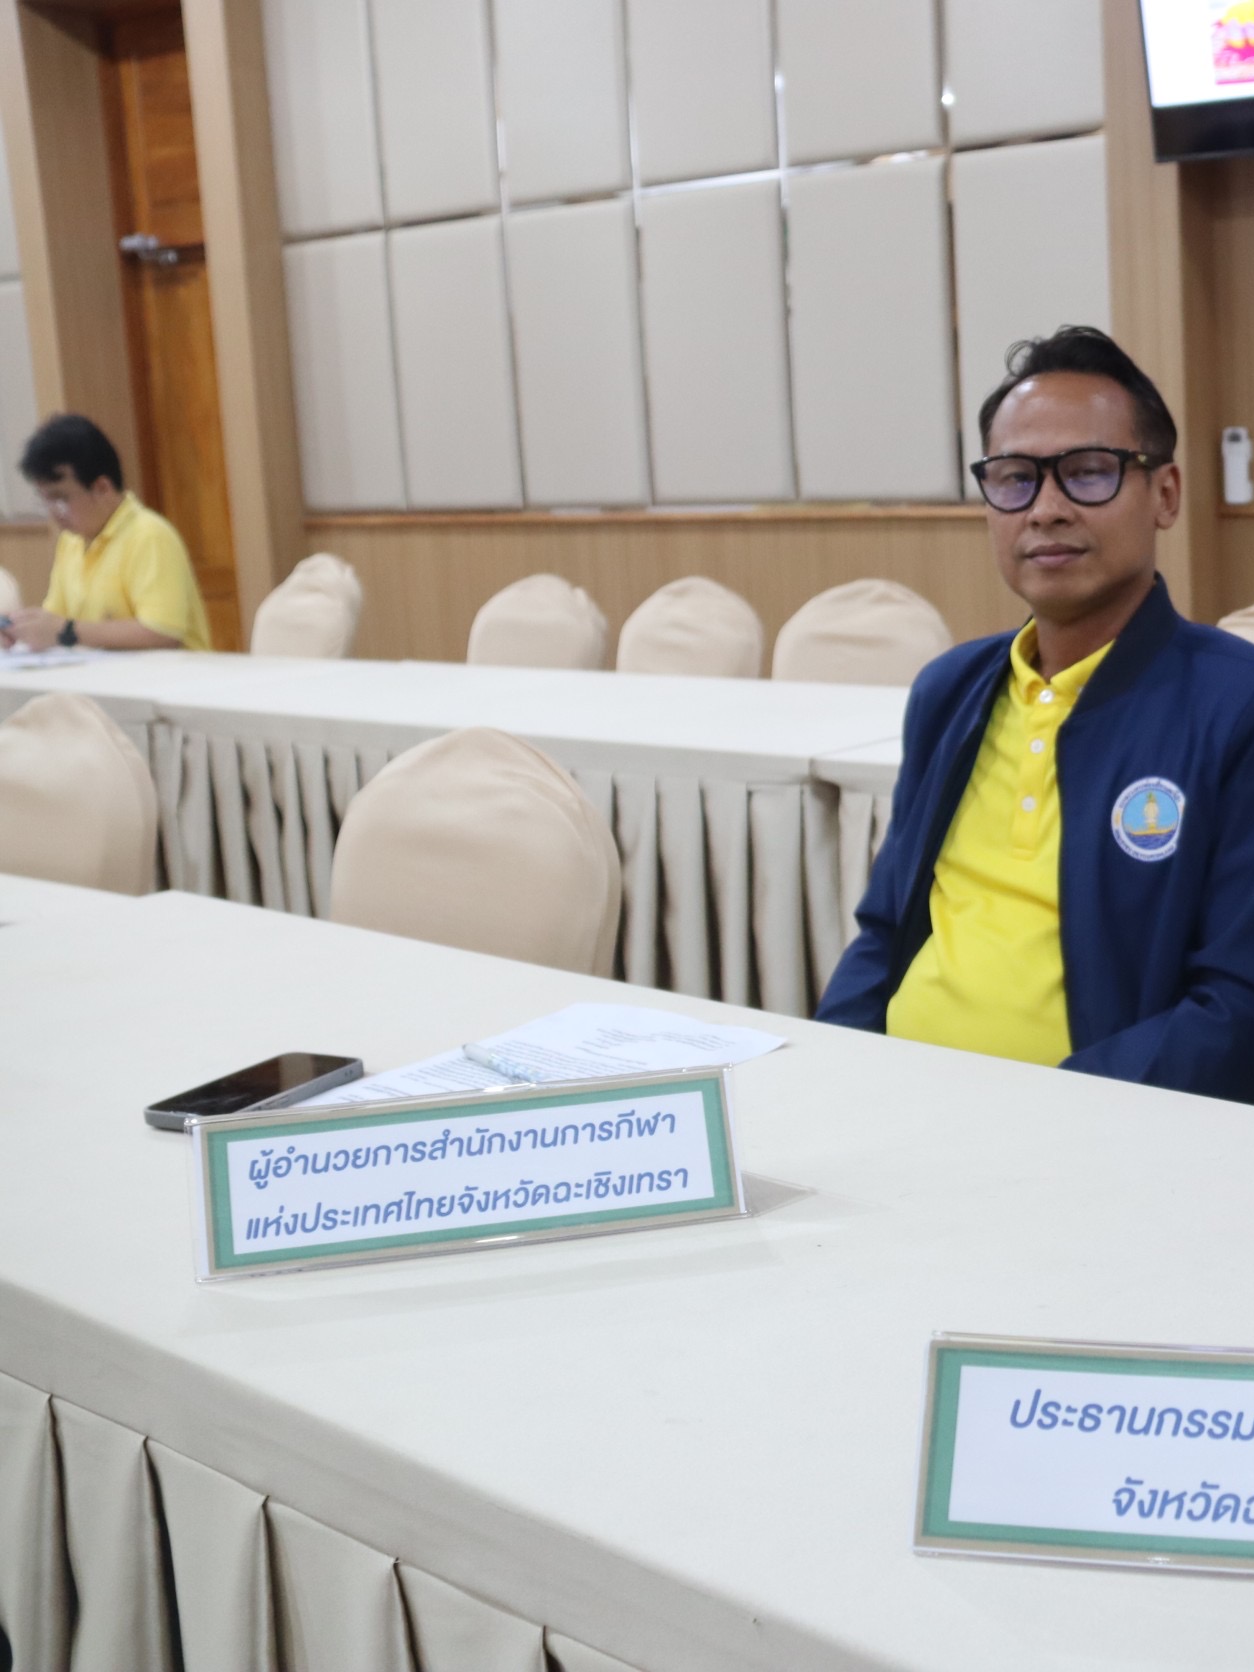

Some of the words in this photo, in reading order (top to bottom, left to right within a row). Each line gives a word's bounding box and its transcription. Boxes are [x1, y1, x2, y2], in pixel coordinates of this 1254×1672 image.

[247, 1110, 676, 1191] ผู้อำนวยการสำนักงานการกีฬา
[244, 1165, 689, 1241] แห่งประเทศไทยจังหวัดฉะเชิงเทรา
